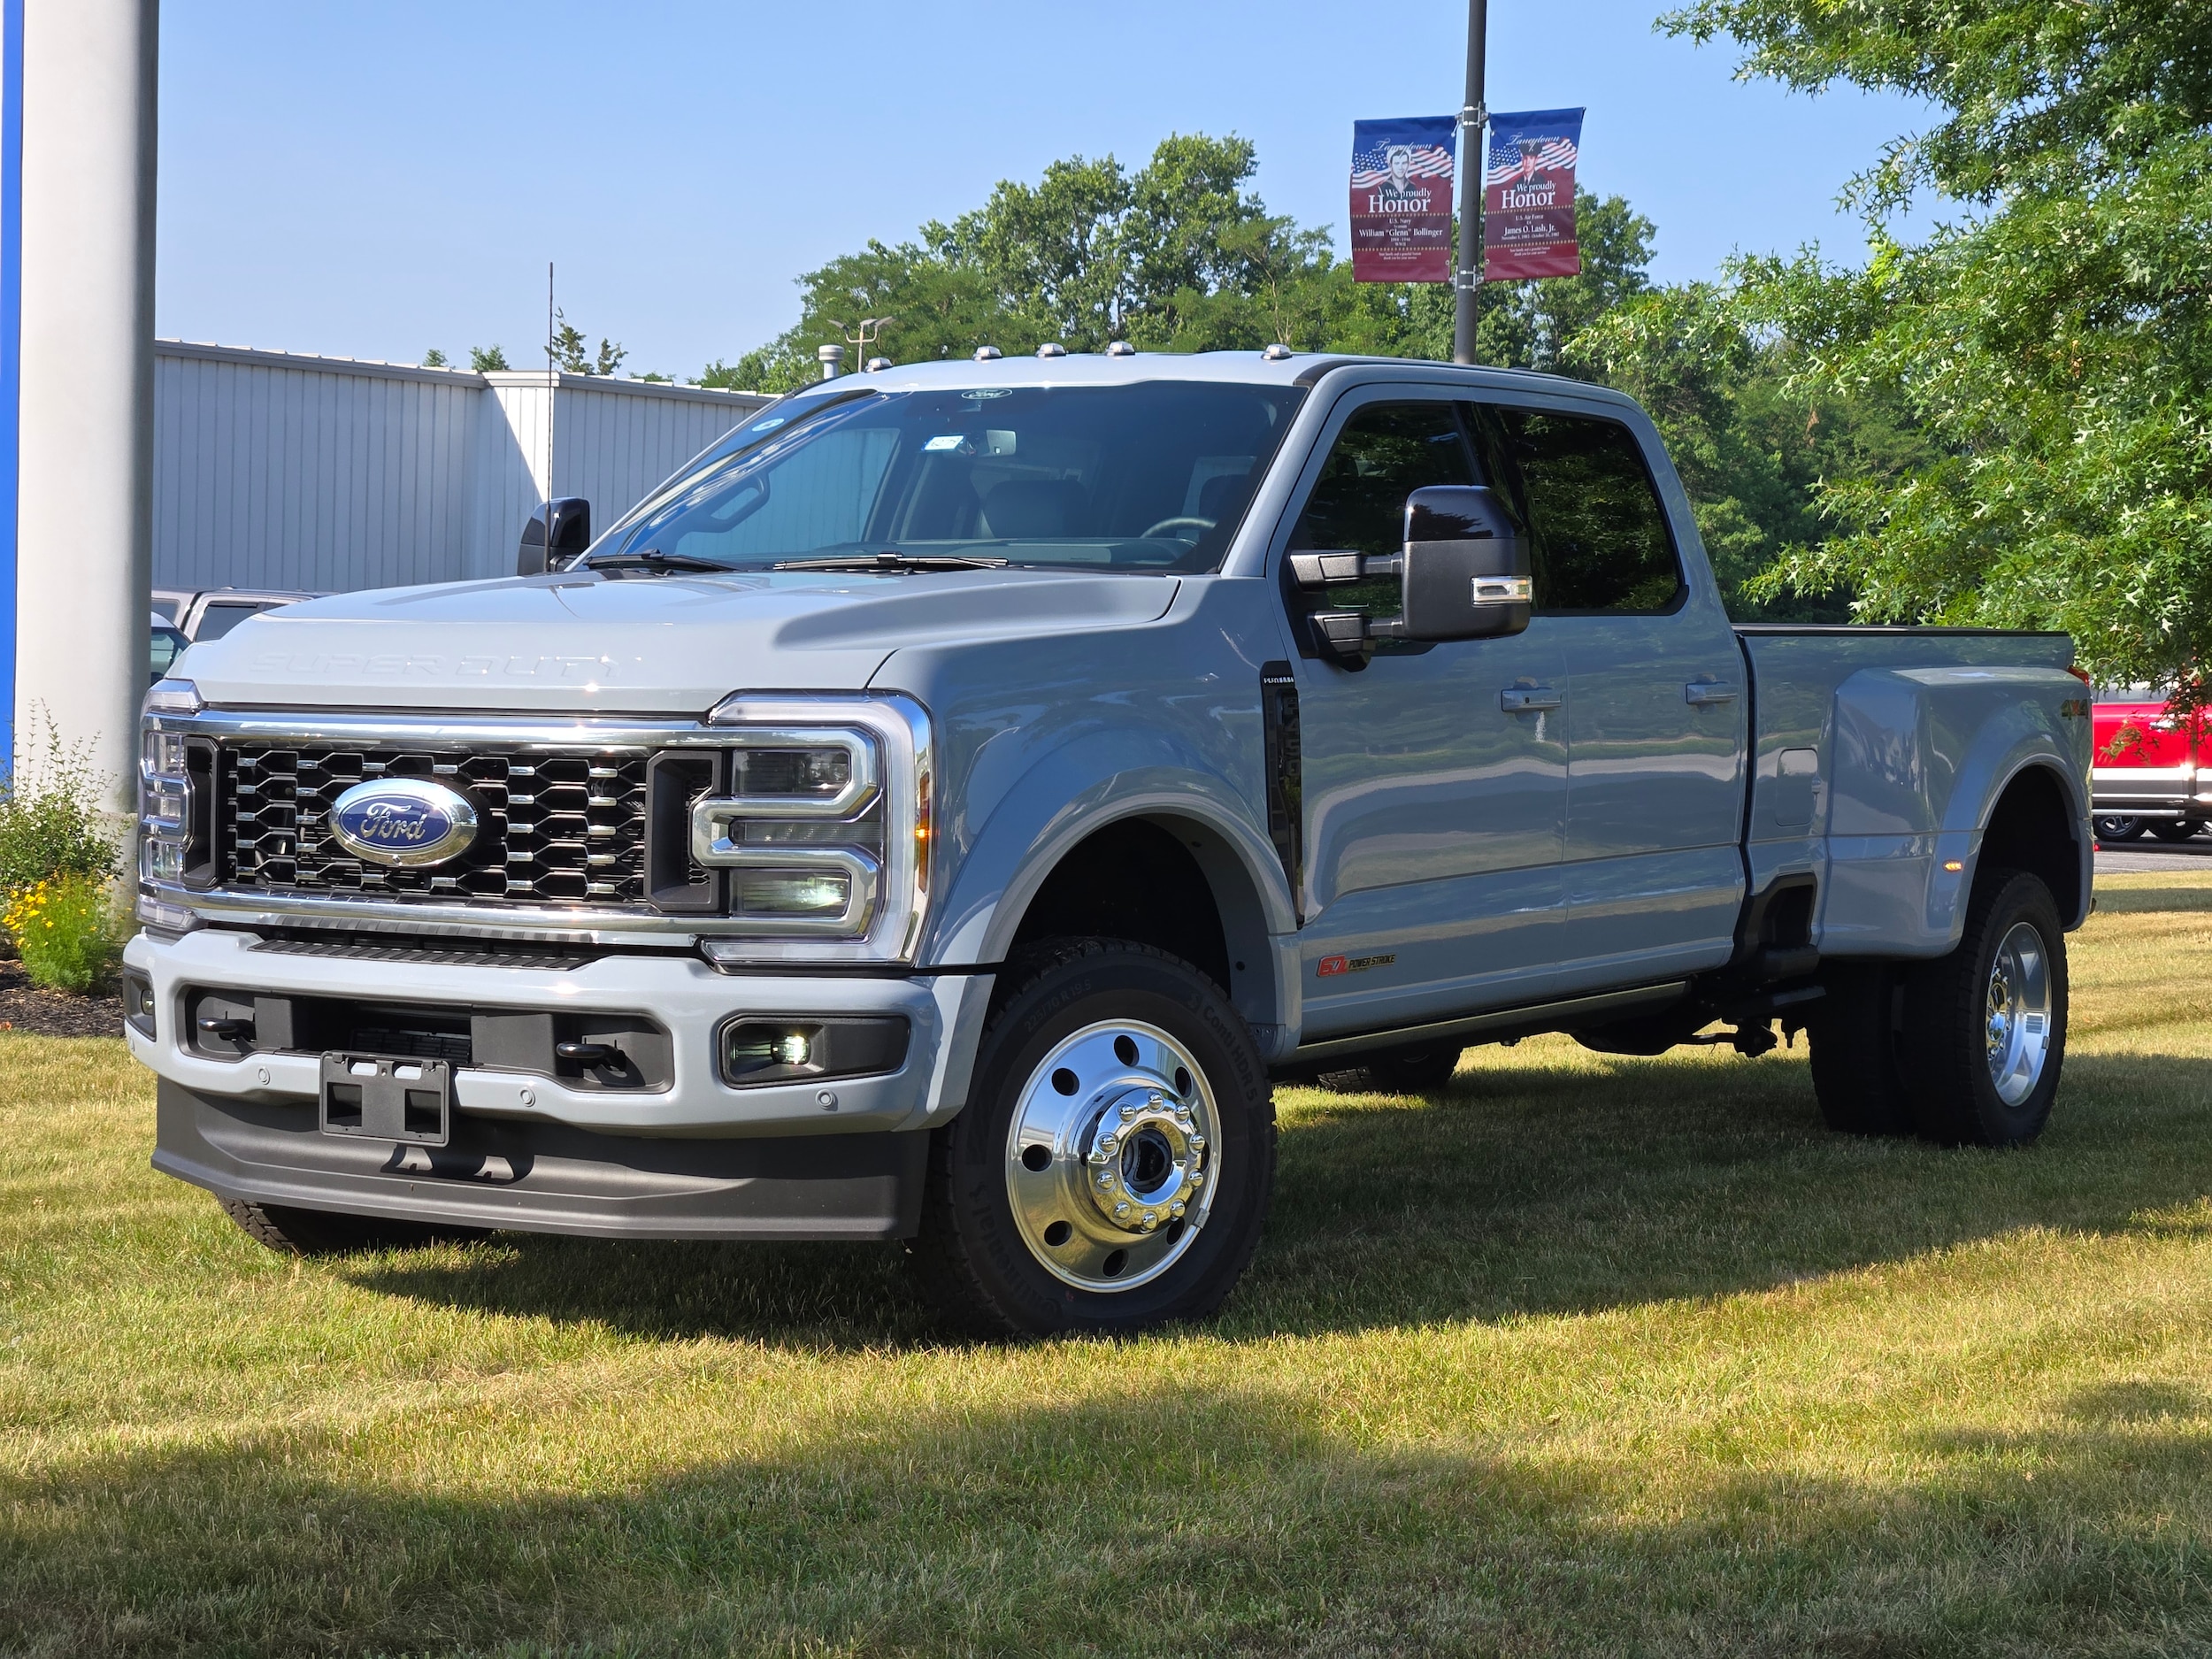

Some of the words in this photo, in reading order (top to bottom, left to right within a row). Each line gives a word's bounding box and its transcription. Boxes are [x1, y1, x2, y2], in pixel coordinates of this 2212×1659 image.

[1385, 188, 1398, 197] We
[1400, 187, 1432, 200] proudly
[1517, 183, 1527, 192] We
[1528, 180, 1556, 194] proudly
[1368, 195, 1431, 213] Honor
[1502, 189, 1555, 209] Honor
[1359, 228, 1385, 237] William
[1413, 227, 1443, 238] Bollinger
[1504, 227, 1522, 236] James
[251, 652, 448, 677] SUPER
[455, 653, 623, 680] DUTY
[359, 801, 428, 840] Ford
[1348, 956, 1371, 969] POWER
[1371, 954, 1396, 965] STROKE
[1203, 1005, 1236, 1048] Conti
[1231, 1045, 1254, 1087] HDR
